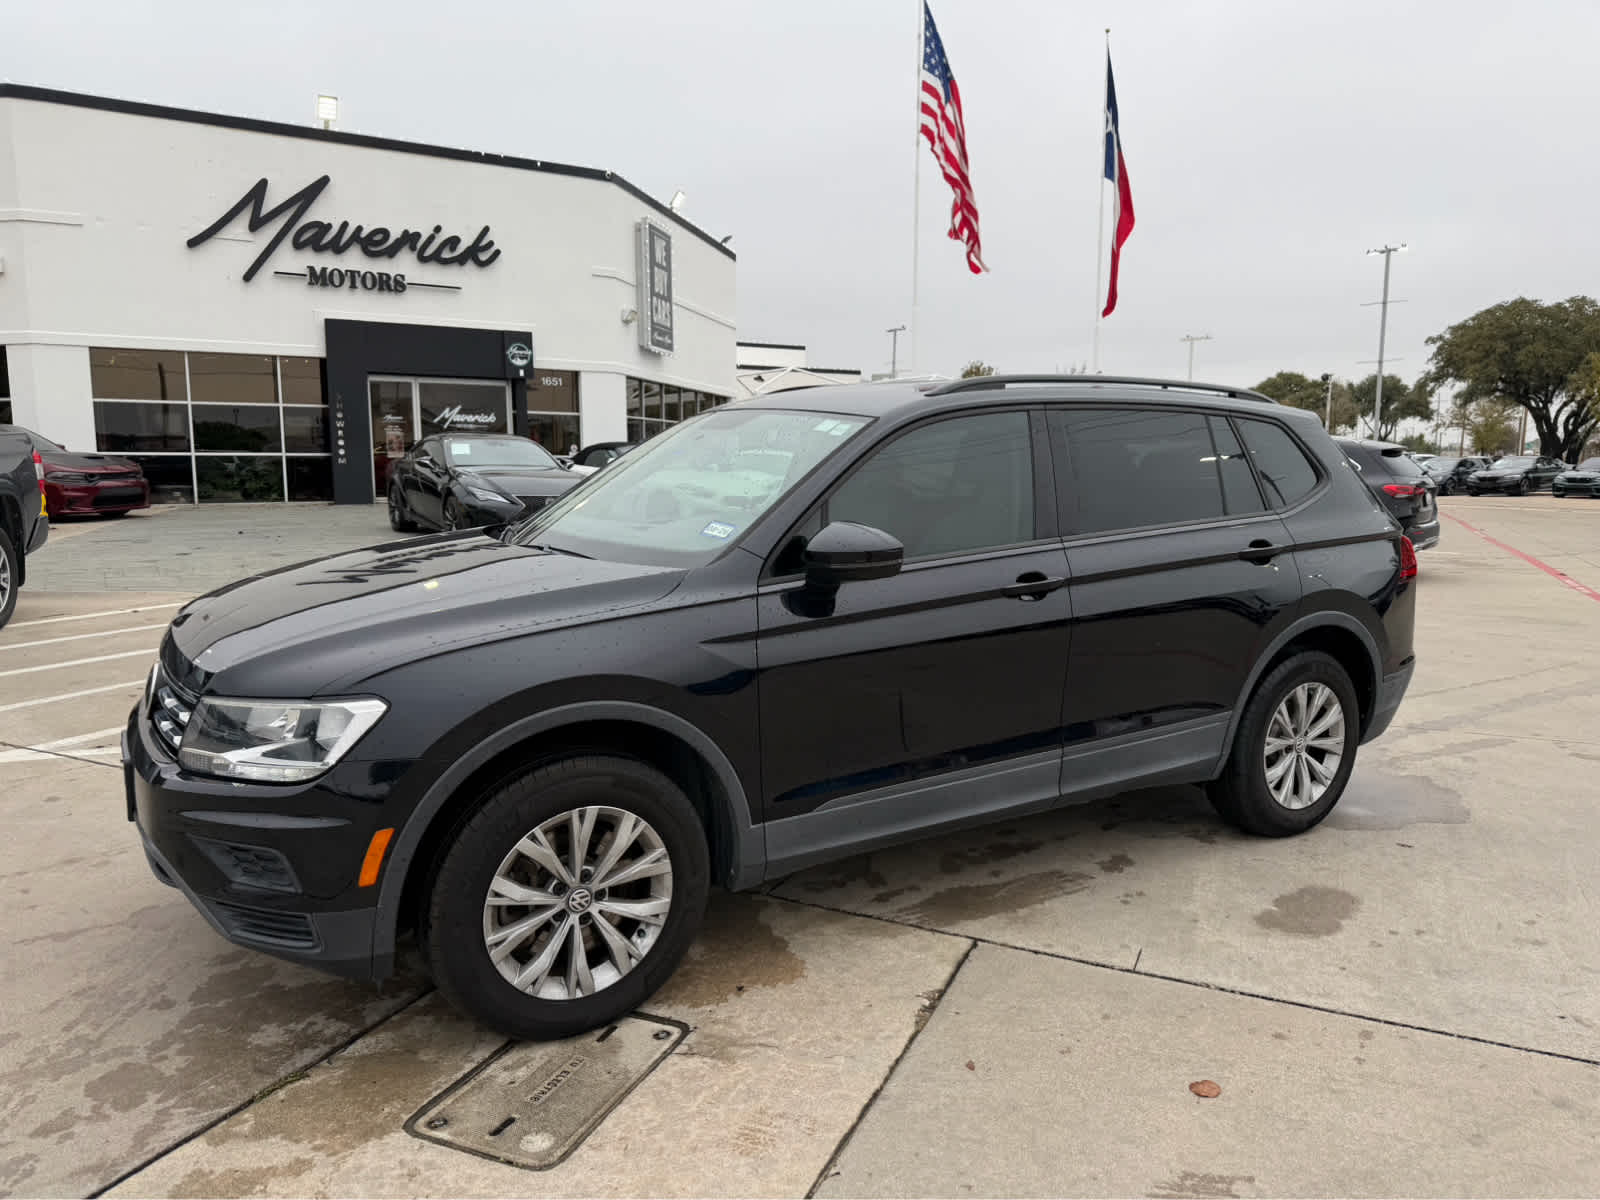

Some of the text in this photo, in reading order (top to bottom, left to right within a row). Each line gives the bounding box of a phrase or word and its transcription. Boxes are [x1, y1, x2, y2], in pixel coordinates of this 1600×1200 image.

[187, 175, 501, 282] Maverick
[654, 235, 667, 267] WE
[306, 266, 407, 293] MOTORS
[653, 295, 671, 328] CARS
[541, 376, 563, 386] 1651
[335, 392, 347, 465] HOWROOM
[433, 405, 497, 429] Maverick
